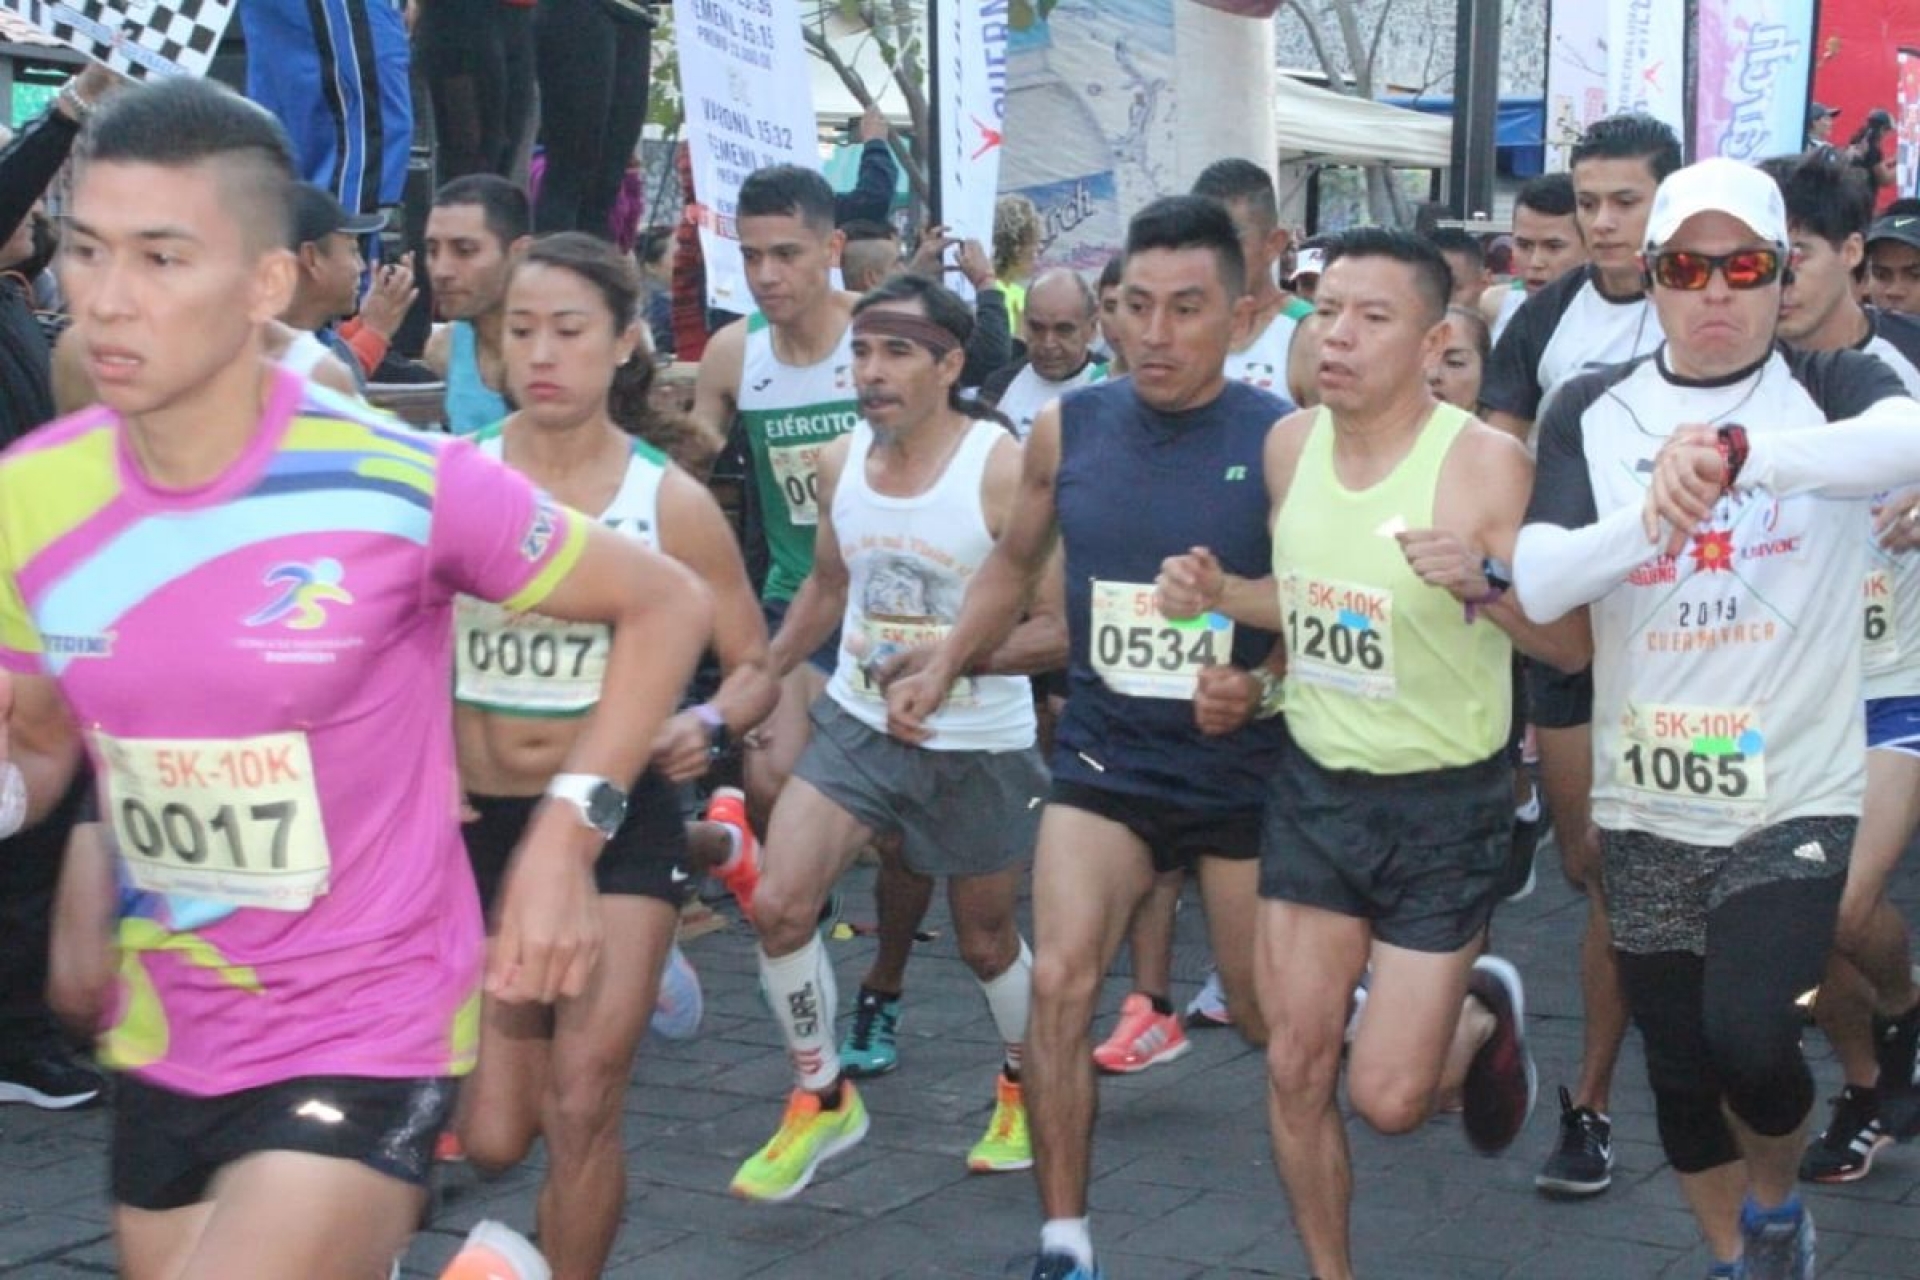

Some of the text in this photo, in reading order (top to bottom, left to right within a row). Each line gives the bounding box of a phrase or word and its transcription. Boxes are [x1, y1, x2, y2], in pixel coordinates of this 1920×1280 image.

[765, 412, 858, 438] EJÉRCITO
[1307, 581, 1387, 622] 5K-10K
[468, 629, 595, 677] 0007
[1098, 624, 1217, 671] 0534
[1287, 610, 1385, 670] 1206
[1654, 711, 1750, 740] 5K-10K
[154, 743, 301, 789] 5K-10K
[1623, 743, 1749, 798] 1065
[121, 797, 298, 870] 0017
